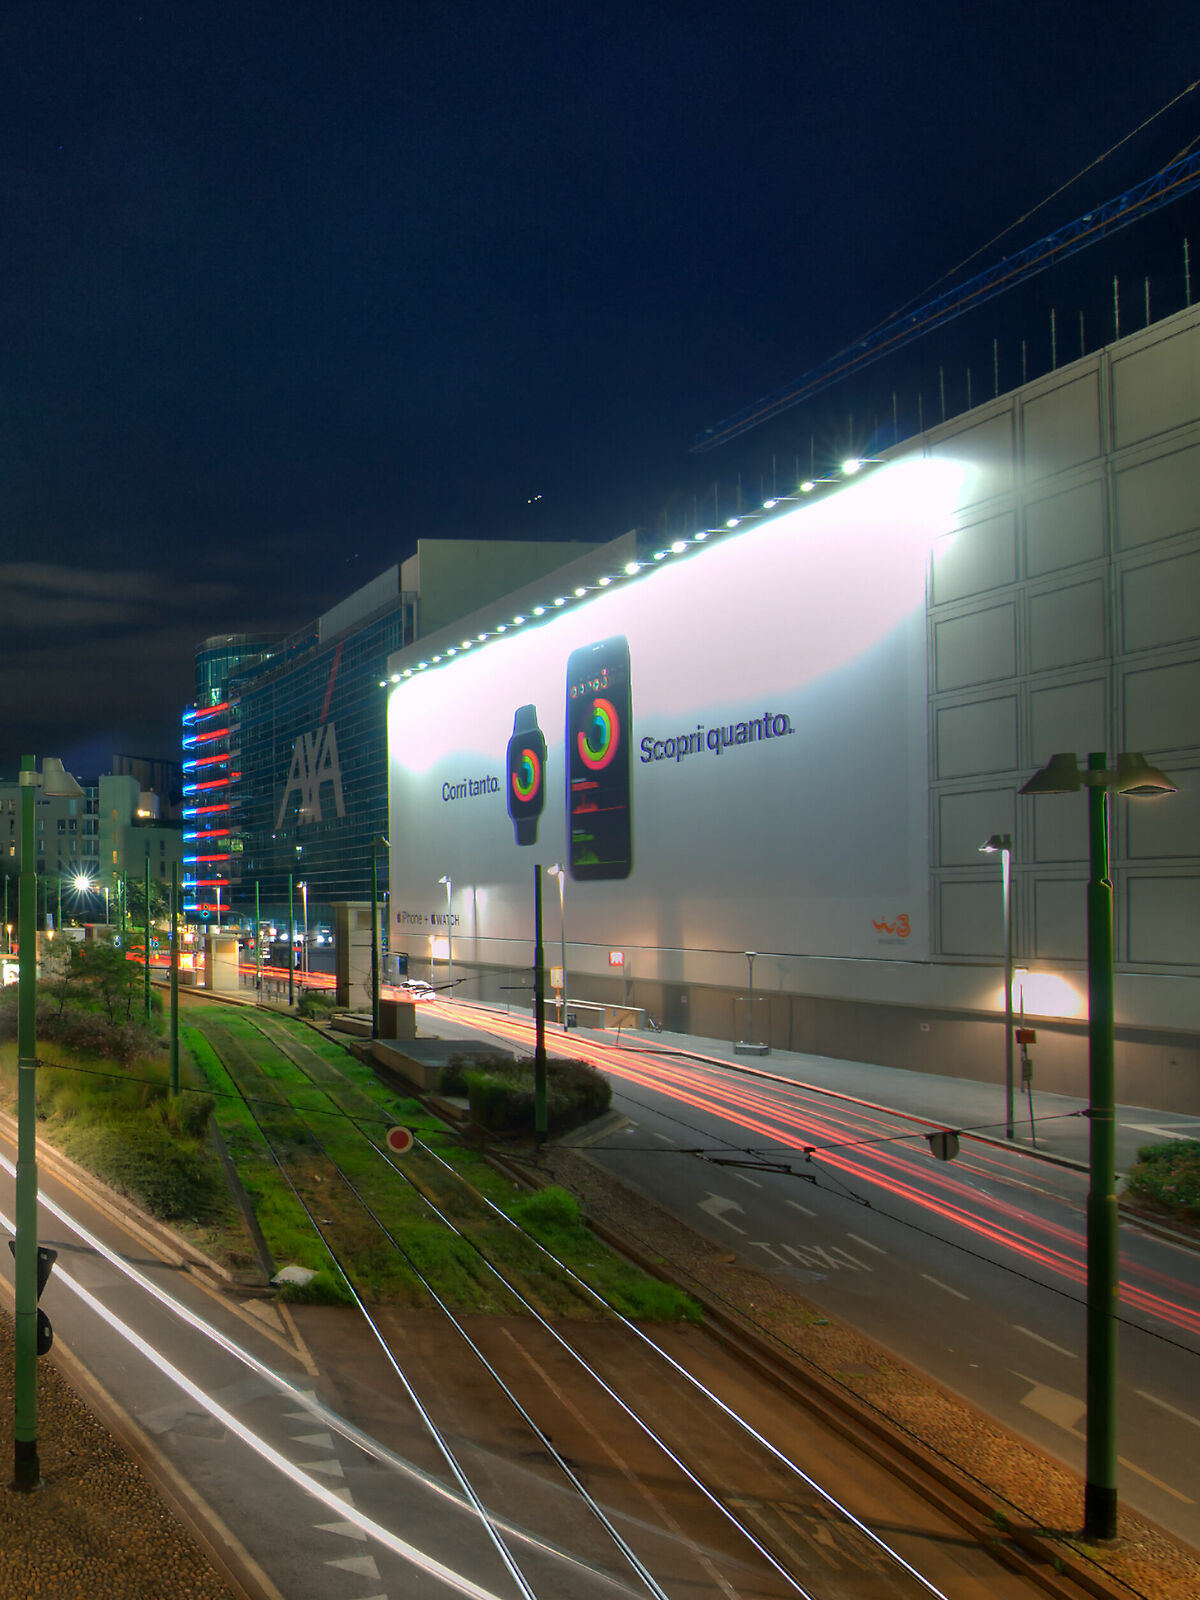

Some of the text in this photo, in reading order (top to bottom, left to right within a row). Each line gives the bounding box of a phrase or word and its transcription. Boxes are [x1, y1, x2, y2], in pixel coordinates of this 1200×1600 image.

[640, 711, 796, 763] Scopri quanto.
[275, 721, 346, 831] AXA
[441, 774, 501, 802] Corri tanto.
[401, 911, 423, 925] iPhone
[435, 914, 461, 926] WATCH
[747, 1241, 874, 1272] TAXI
